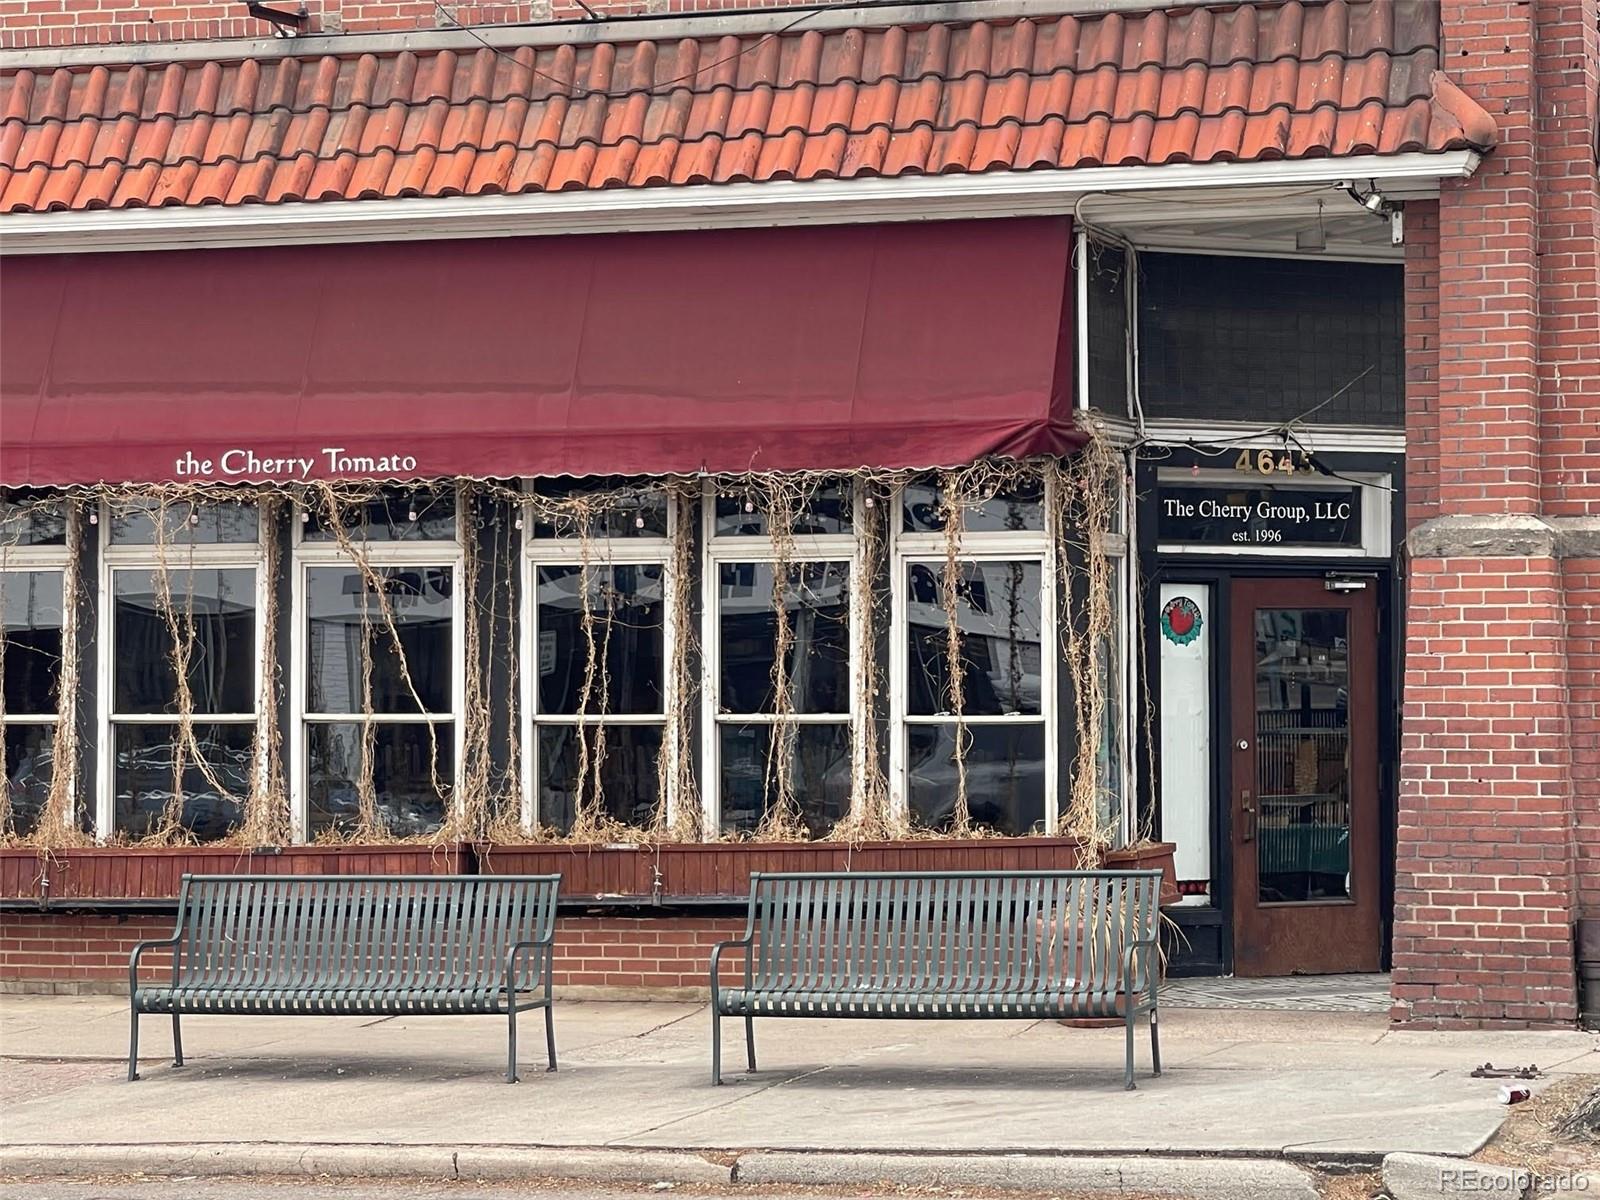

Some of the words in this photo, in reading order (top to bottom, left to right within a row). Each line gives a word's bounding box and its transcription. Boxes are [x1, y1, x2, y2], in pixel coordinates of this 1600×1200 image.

[175, 450, 214, 475] the
[220, 449, 315, 478] Cherry
[321, 447, 417, 473] Tomato
[1164, 499, 1194, 517] The
[1198, 499, 1253, 522] Cherry
[1256, 501, 1310, 523] Group,
[1314, 502, 1350, 520] LLC
[1232, 531, 1251, 542] est.
[1255, 529, 1282, 543] 1996
